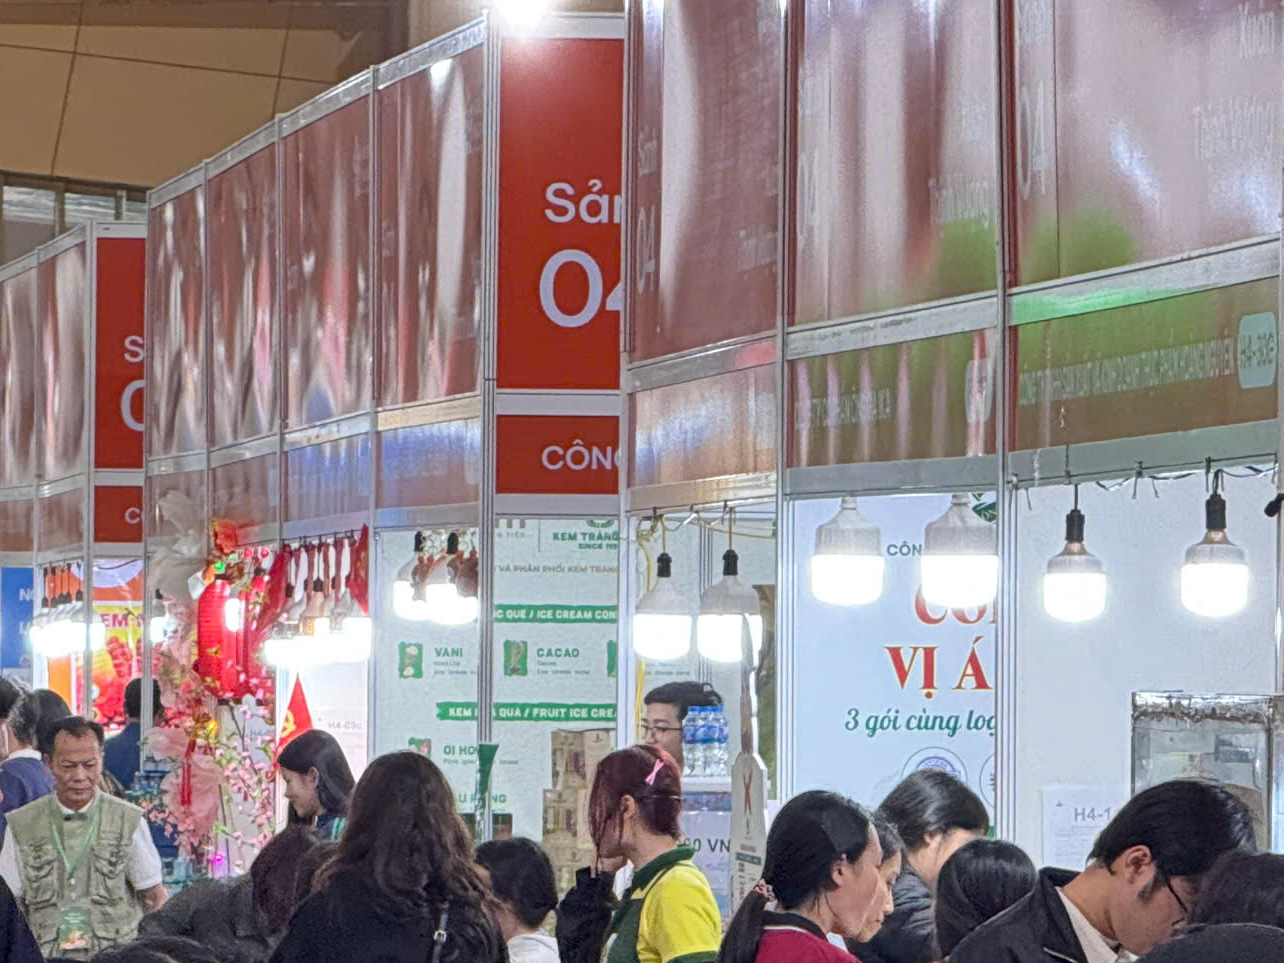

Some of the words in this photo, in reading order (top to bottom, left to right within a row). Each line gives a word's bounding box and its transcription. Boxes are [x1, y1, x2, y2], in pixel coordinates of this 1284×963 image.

[124, 507, 144, 524] C
[553, 532, 577, 541] KEM
[537, 609, 554, 619] ICE
[556, 609, 593, 619] CREAM
[435, 648, 463, 657] VANI
[536, 648, 580, 657] CACAO
[884, 646, 939, 699] VỊ
[449, 707, 472, 717] KEM
[533, 708, 566, 718] FRUIT
[569, 708, 588, 718] ICE
[845, 708, 859, 731] 3
[865, 708, 902, 737] gói
[905, 708, 962, 737] cùng
